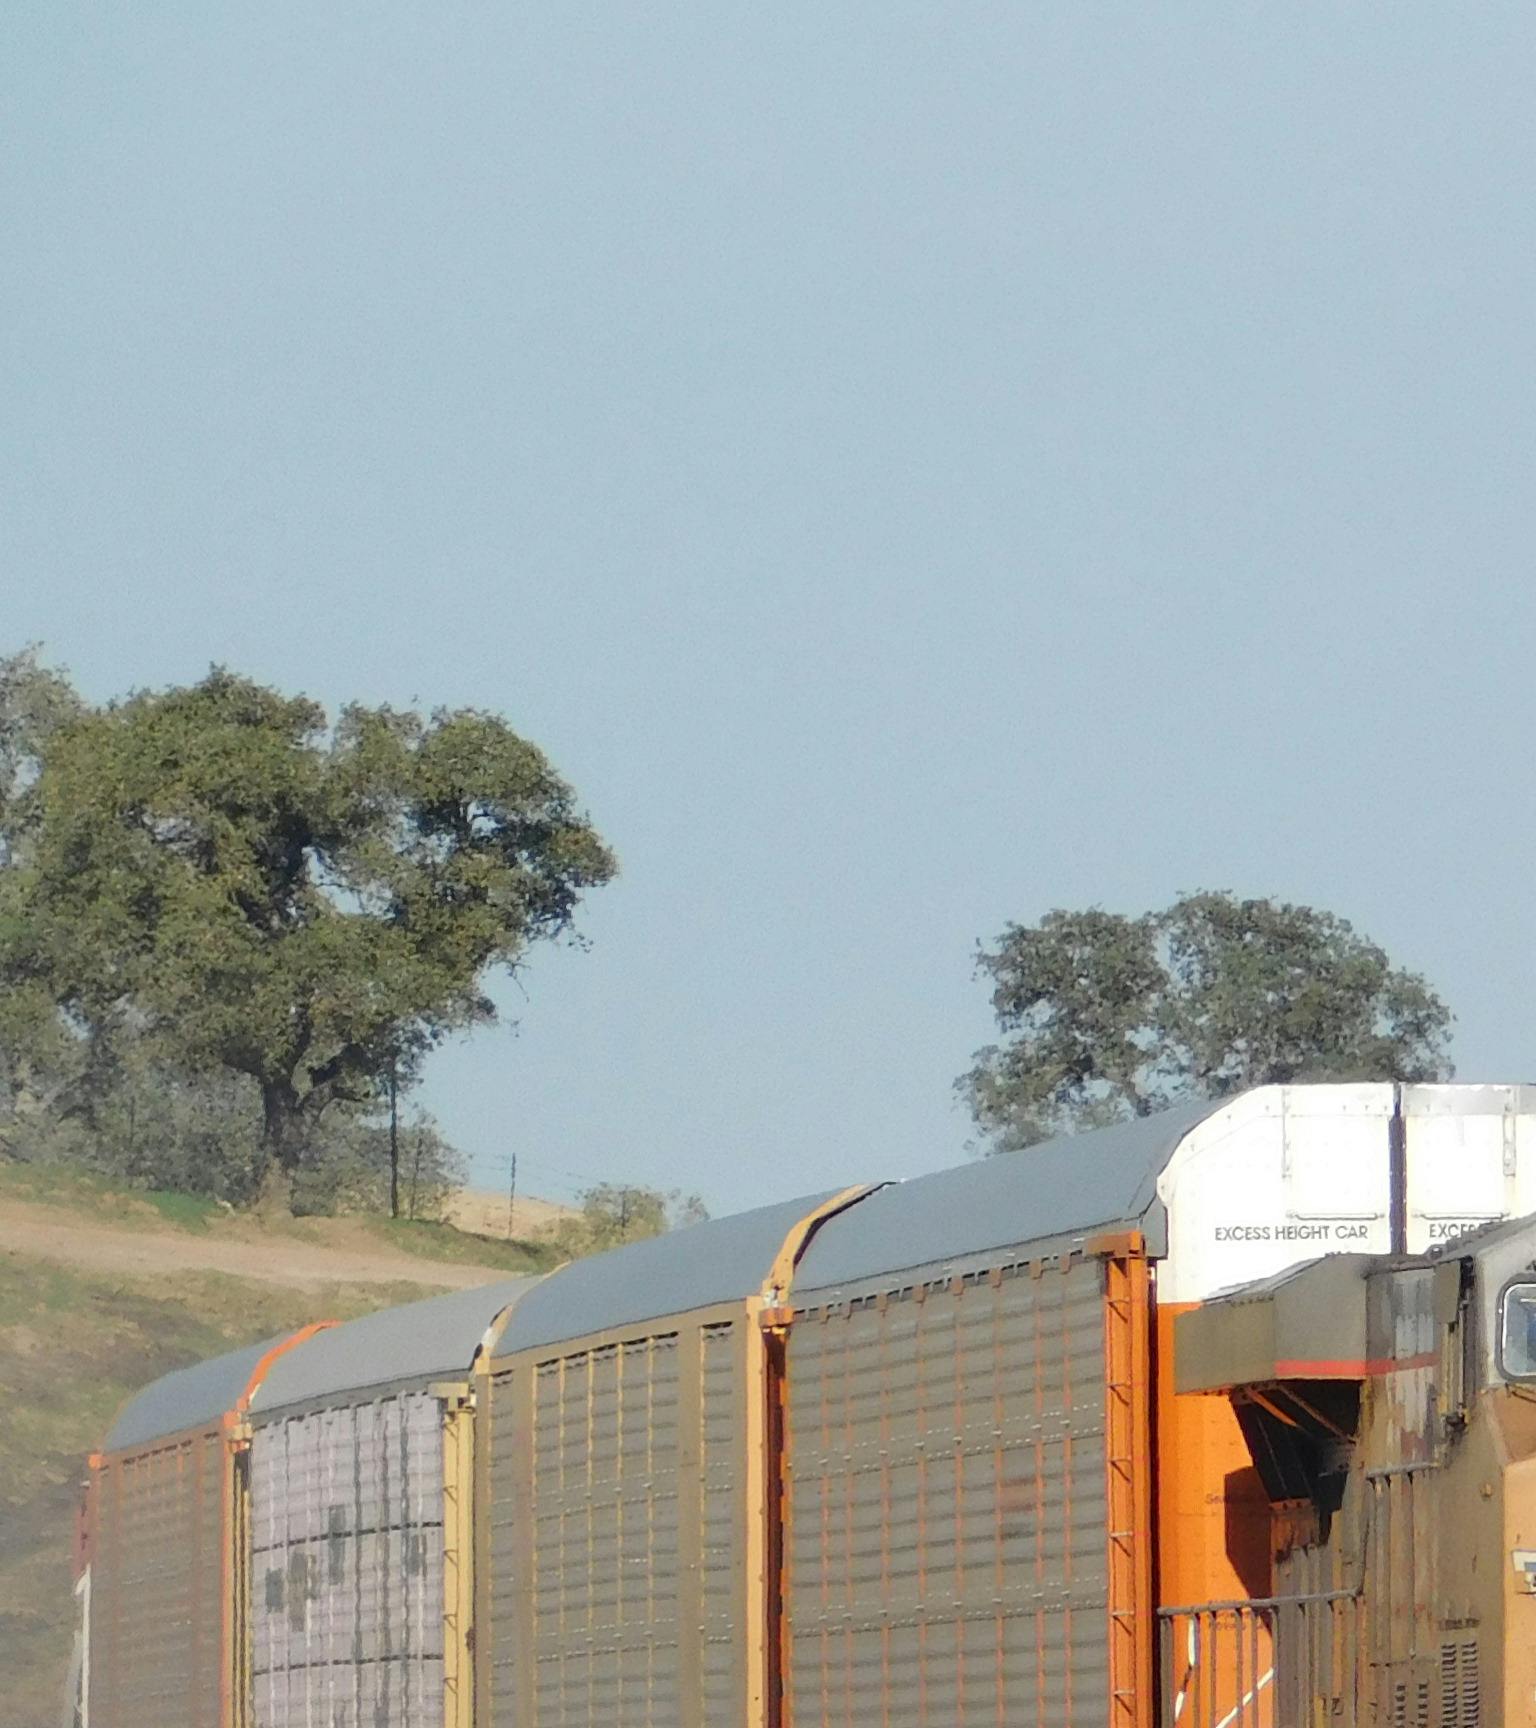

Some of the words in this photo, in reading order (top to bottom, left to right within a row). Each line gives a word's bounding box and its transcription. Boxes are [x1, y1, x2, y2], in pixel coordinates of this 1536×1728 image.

[1214, 1226, 1271, 1241] EXCESS
[1275, 1225, 1330, 1240] HEIGHT
[1335, 1225, 1369, 1239] CAR
[1429, 1223, 1477, 1238] EXC
